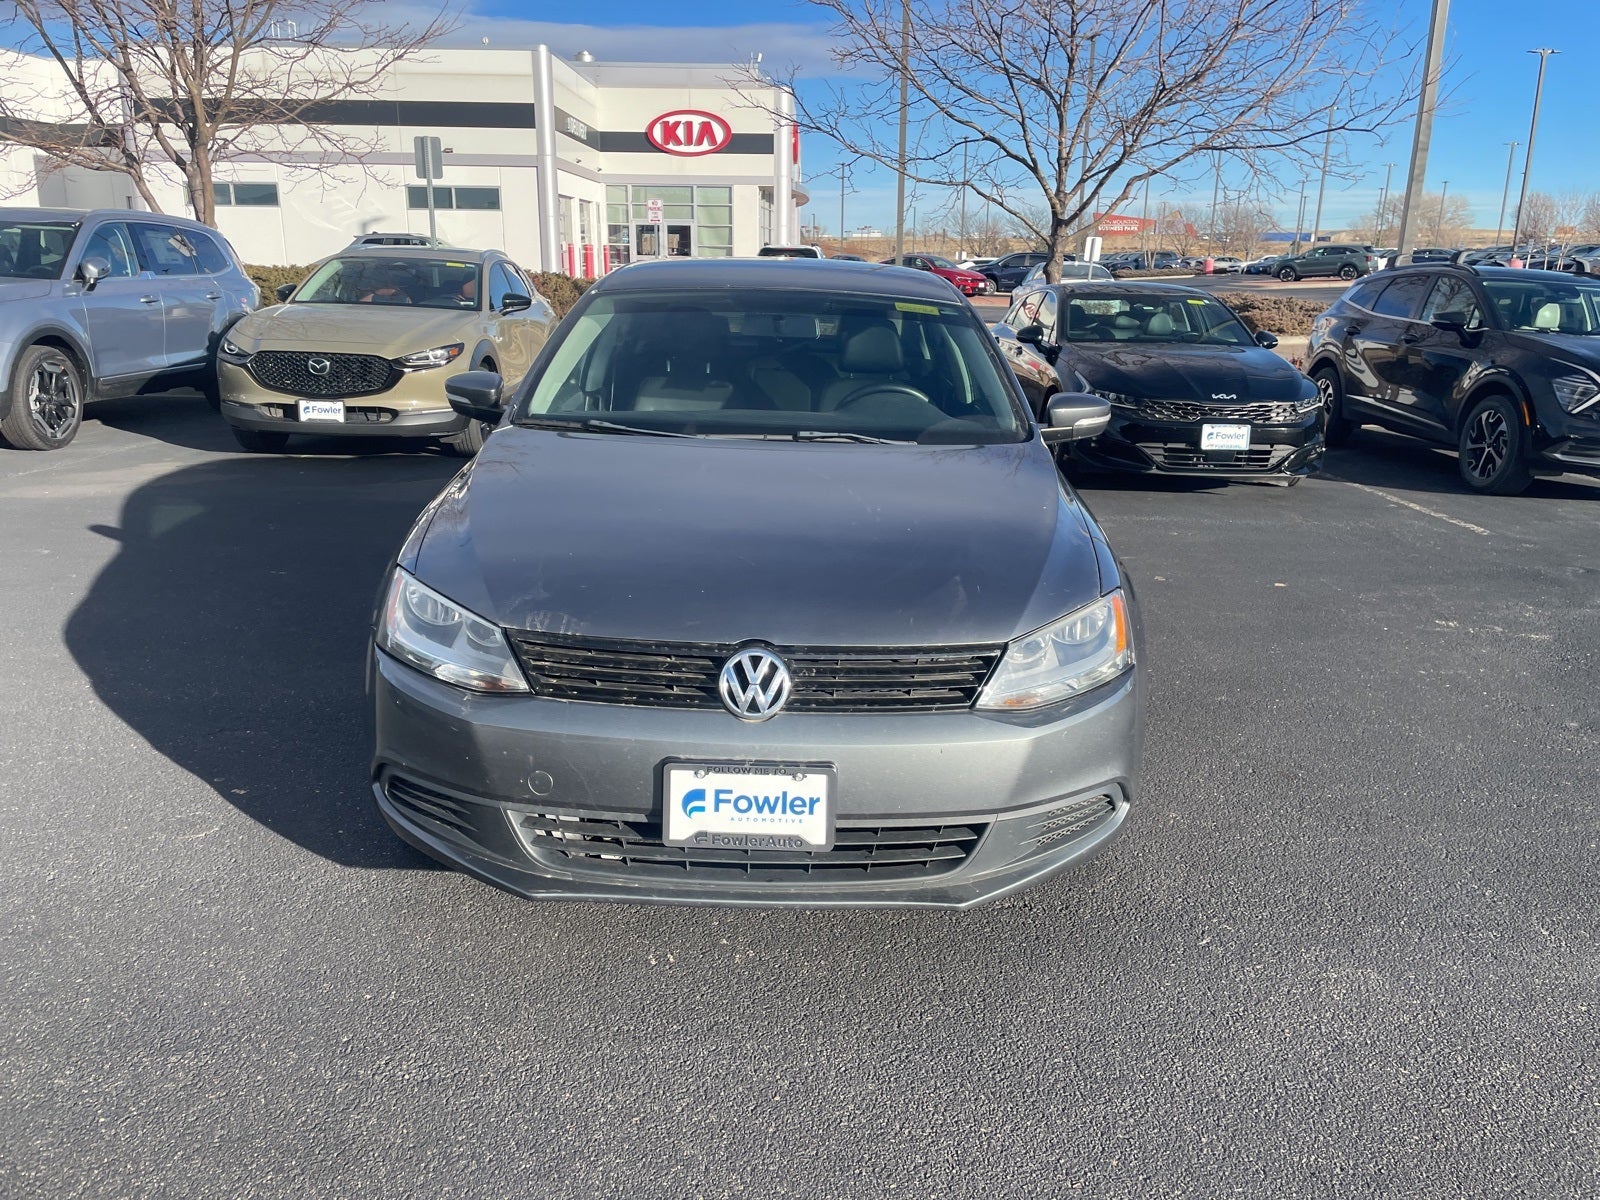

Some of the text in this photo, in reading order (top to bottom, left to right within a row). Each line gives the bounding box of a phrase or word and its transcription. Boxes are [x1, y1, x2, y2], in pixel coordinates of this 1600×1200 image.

[659, 121, 717, 146] KIA
[311, 405, 342, 414] Fowler
[1215, 431, 1246, 440] Fowler
[706, 766, 750, 774] FOLLOW
[754, 767, 770, 775] ME
[713, 788, 821, 816] Fowler
[730, 816, 803, 824] AUTOMOTIVE
[711, 834, 803, 848] FowlerAuto
